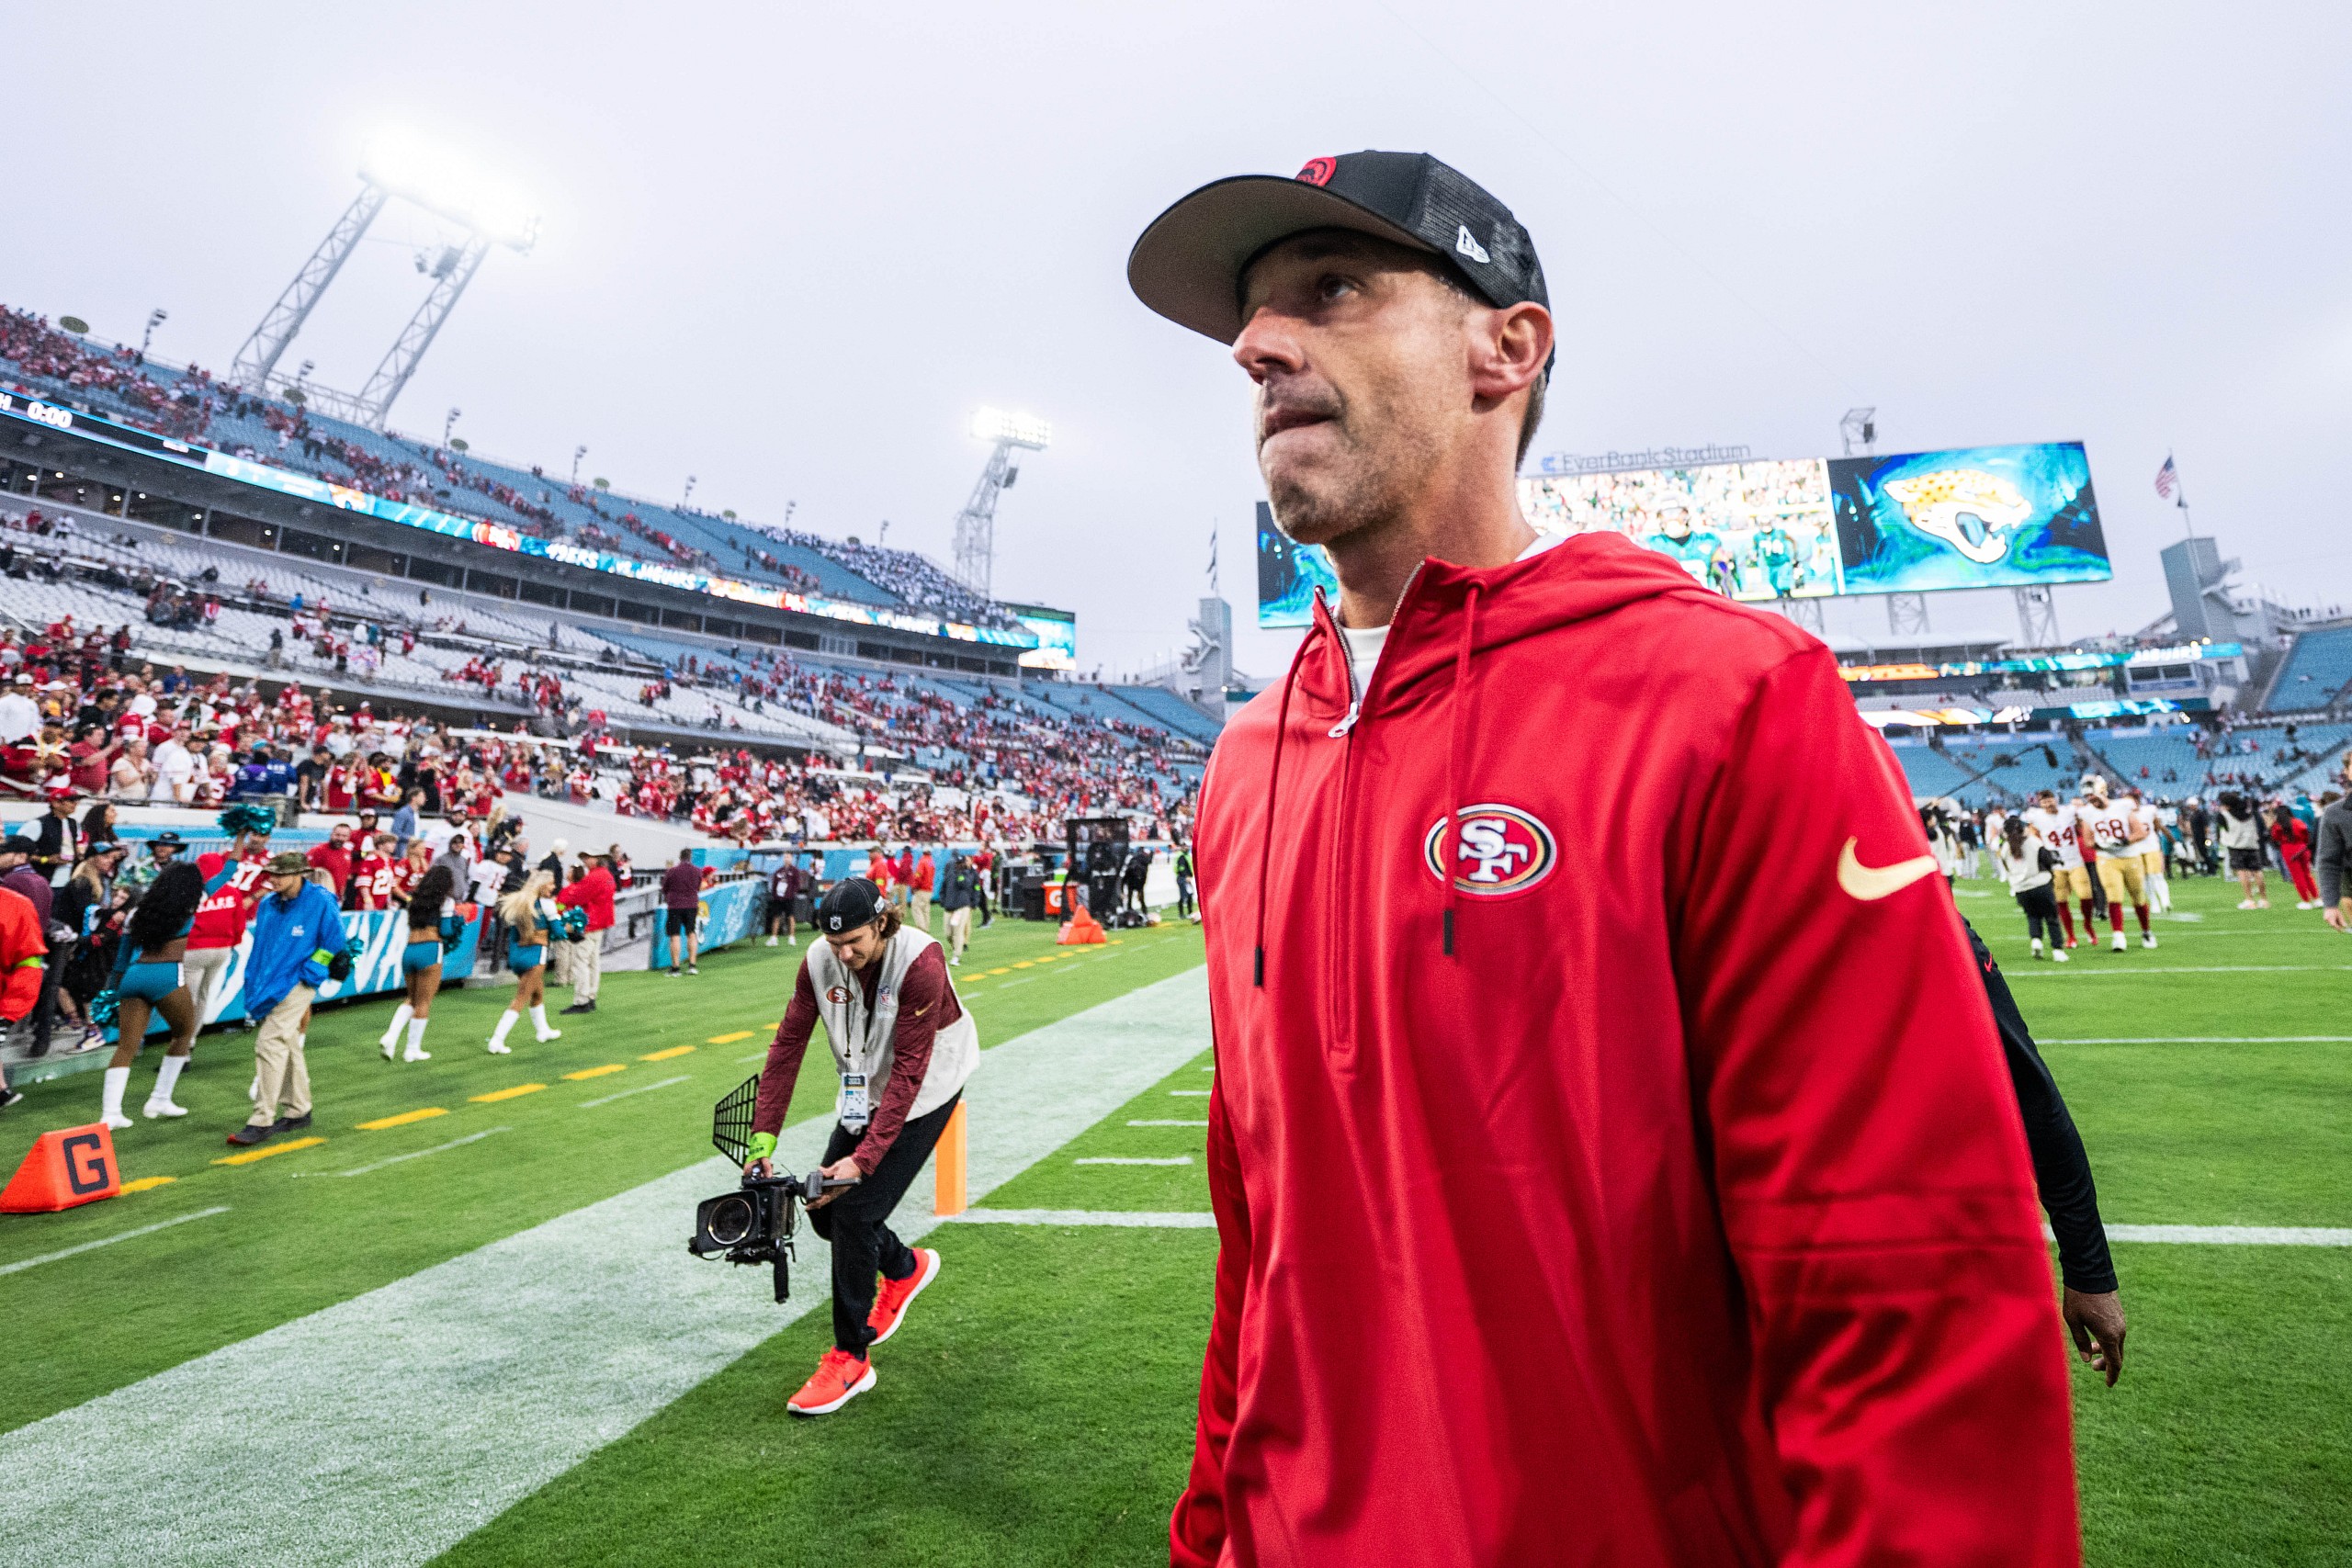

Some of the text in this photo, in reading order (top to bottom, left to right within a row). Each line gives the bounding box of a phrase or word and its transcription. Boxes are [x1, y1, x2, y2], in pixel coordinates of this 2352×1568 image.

[28, 401, 73, 428] 0:00
[1562, 443, 1751, 471] EverBank Stadium
[545, 543, 599, 570] 49ERS
[2048, 826, 2074, 848] 44
[2094, 818, 2125, 840] 68
[1458, 818, 1529, 883] SF
[62, 1133, 109, 1195] G
